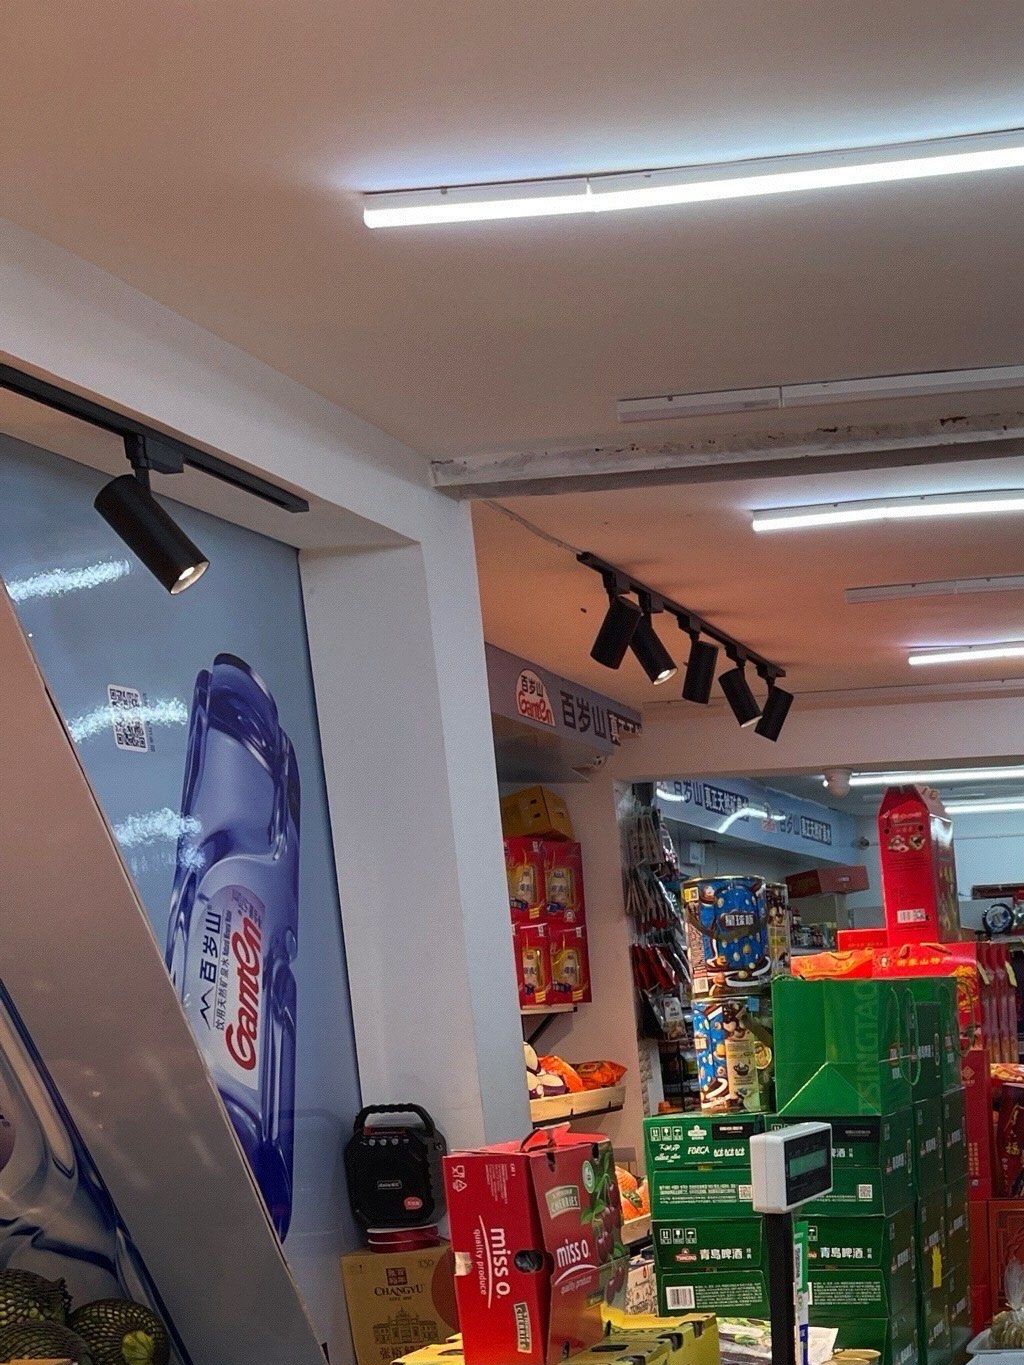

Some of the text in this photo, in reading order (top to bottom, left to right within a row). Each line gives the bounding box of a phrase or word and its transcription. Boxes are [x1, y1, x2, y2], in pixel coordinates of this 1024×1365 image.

[560, 690, 607, 739] 百岁山
[199, 911, 222, 984] 百岁山
[225, 916, 262, 1071] Ganten
[473, 1228, 488, 1296] quality produce
[490, 1227, 511, 1276] miss
[556, 1238, 582, 1268] miss
[700, 1248, 743, 1260] 青岛啤酒
[820, 1247, 864, 1259] 青岛啤酒
[374, 1284, 424, 1298] CHANGYU
